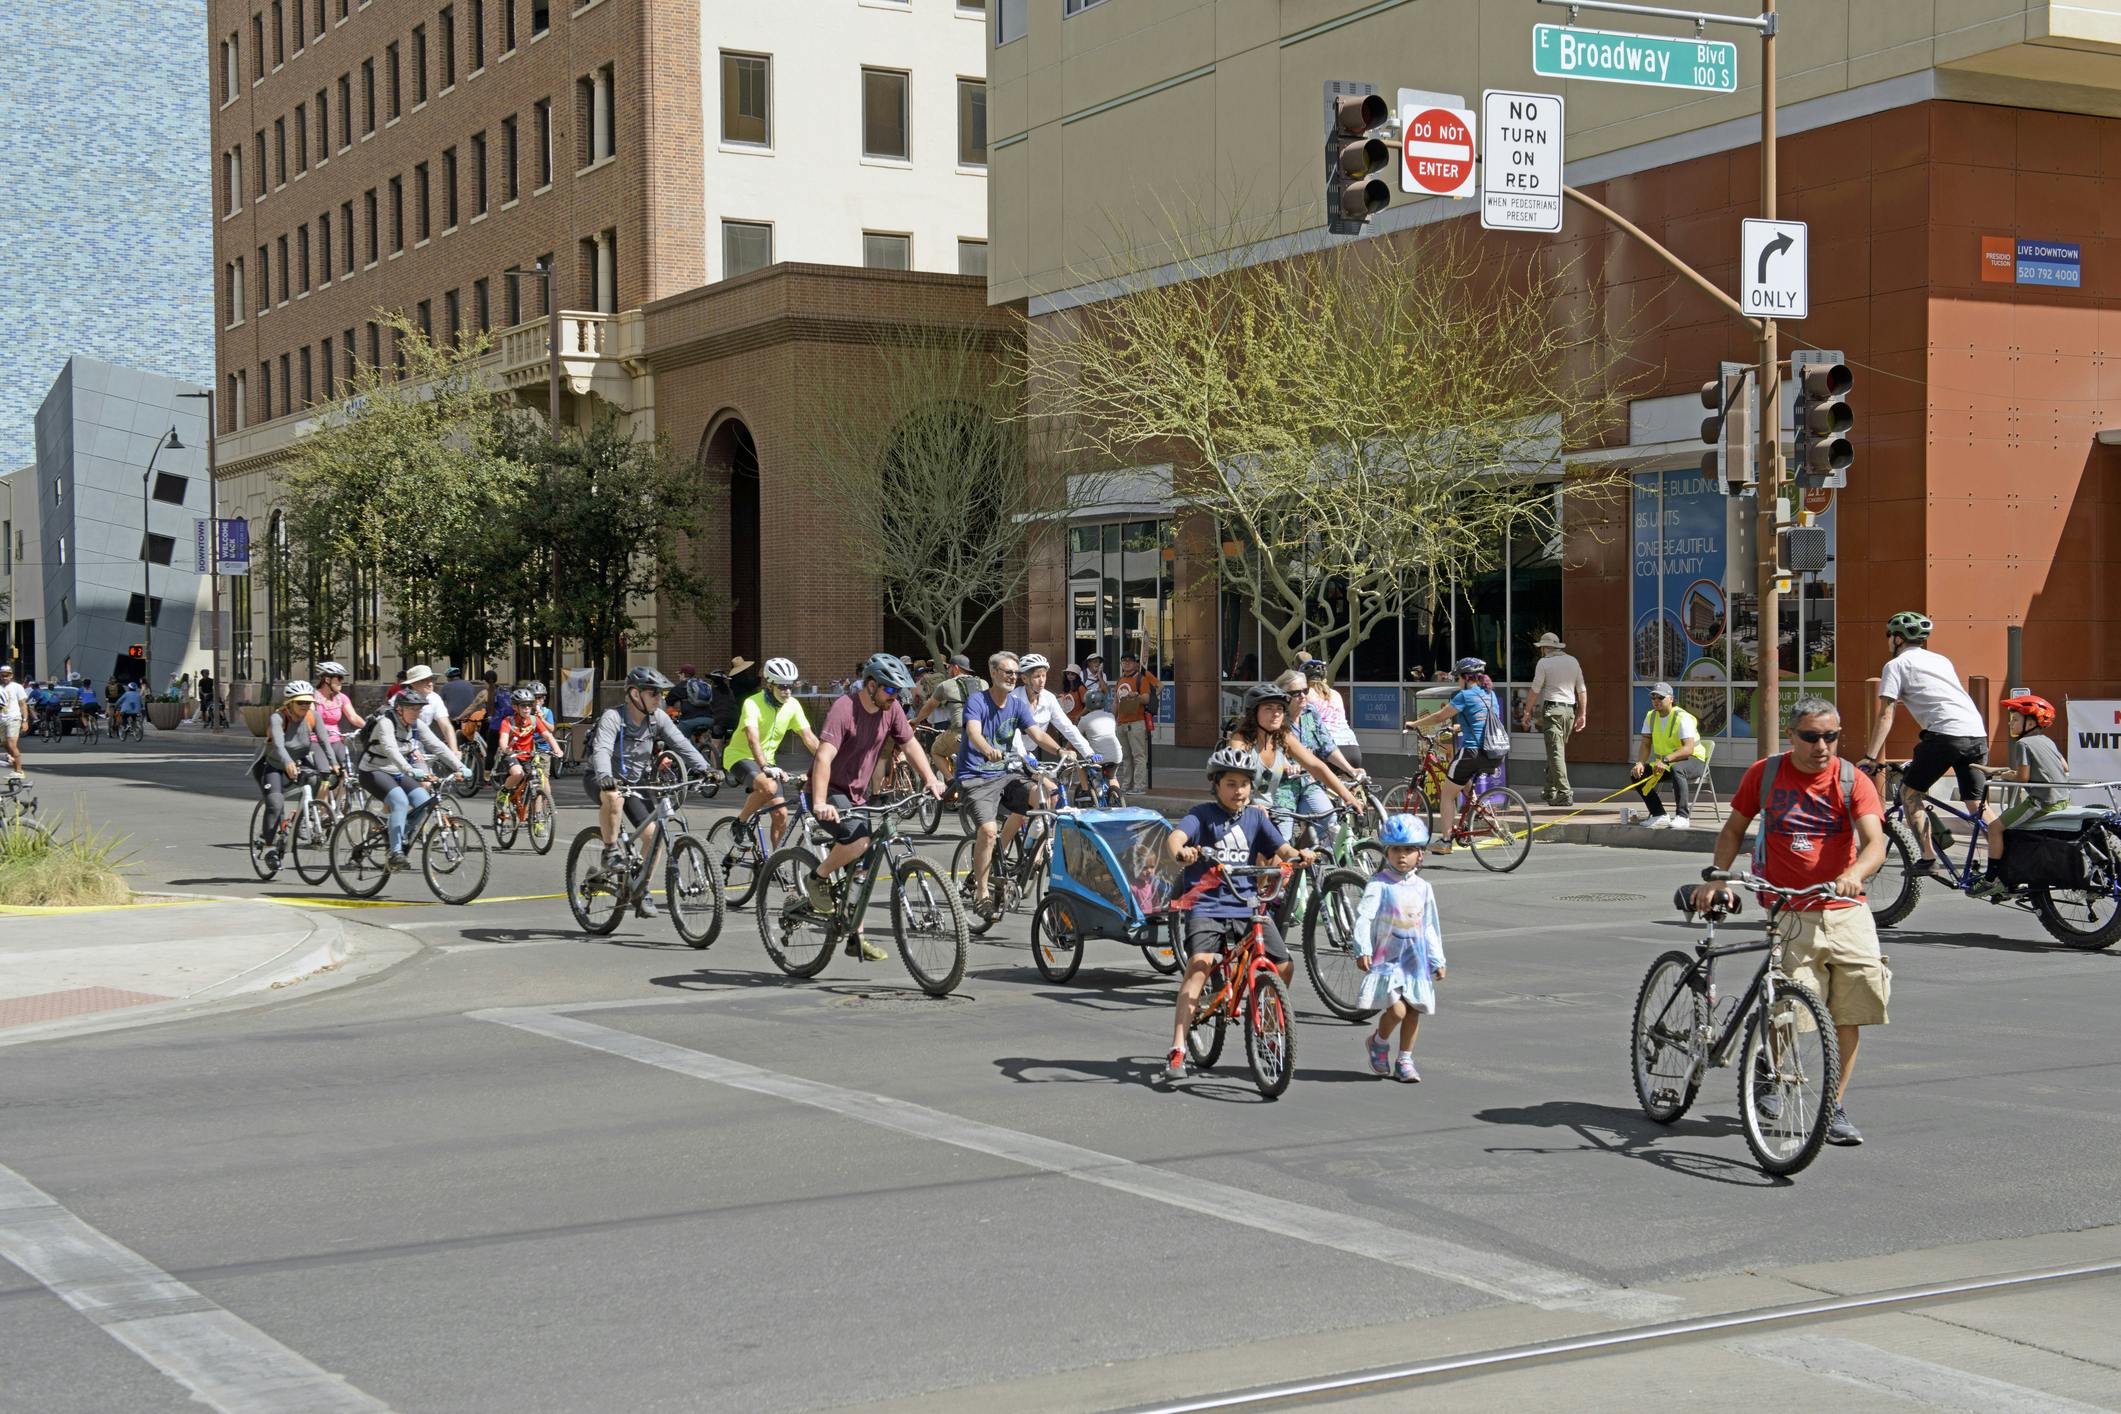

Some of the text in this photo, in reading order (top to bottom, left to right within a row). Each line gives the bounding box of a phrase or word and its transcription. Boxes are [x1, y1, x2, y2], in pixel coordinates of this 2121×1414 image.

[1540, 29, 1725, 81] E Broadway Blvd
[1693, 66, 1729, 87] 100 S
[1510, 101, 1537, 121] NO
[1415, 123, 1464, 141] DO NOT
[1501, 127, 1546, 144] TURN
[1512, 150, 1534, 166] ON
[1419, 161, 1459, 178] ENTER
[1506, 173, 1539, 189] RED
[1488, 197, 1557, 210] WHEN PEDESTRIANS
[1506, 210, 1537, 222] PRESENT
[2017, 246, 2078, 259] LIVE DOWNTOWN
[2018, 267, 2078, 281] 520 792 4000
[1752, 289, 1797, 308] ONLY
[1636, 478, 1718, 499] THRE BUILDING
[1636, 510, 1680, 528] 85 UITS
[198, 521, 206, 572] DOWNTOWN
[1636, 540, 1659, 558] ONE
[1636, 557, 1704, 577] COMMUNITY
